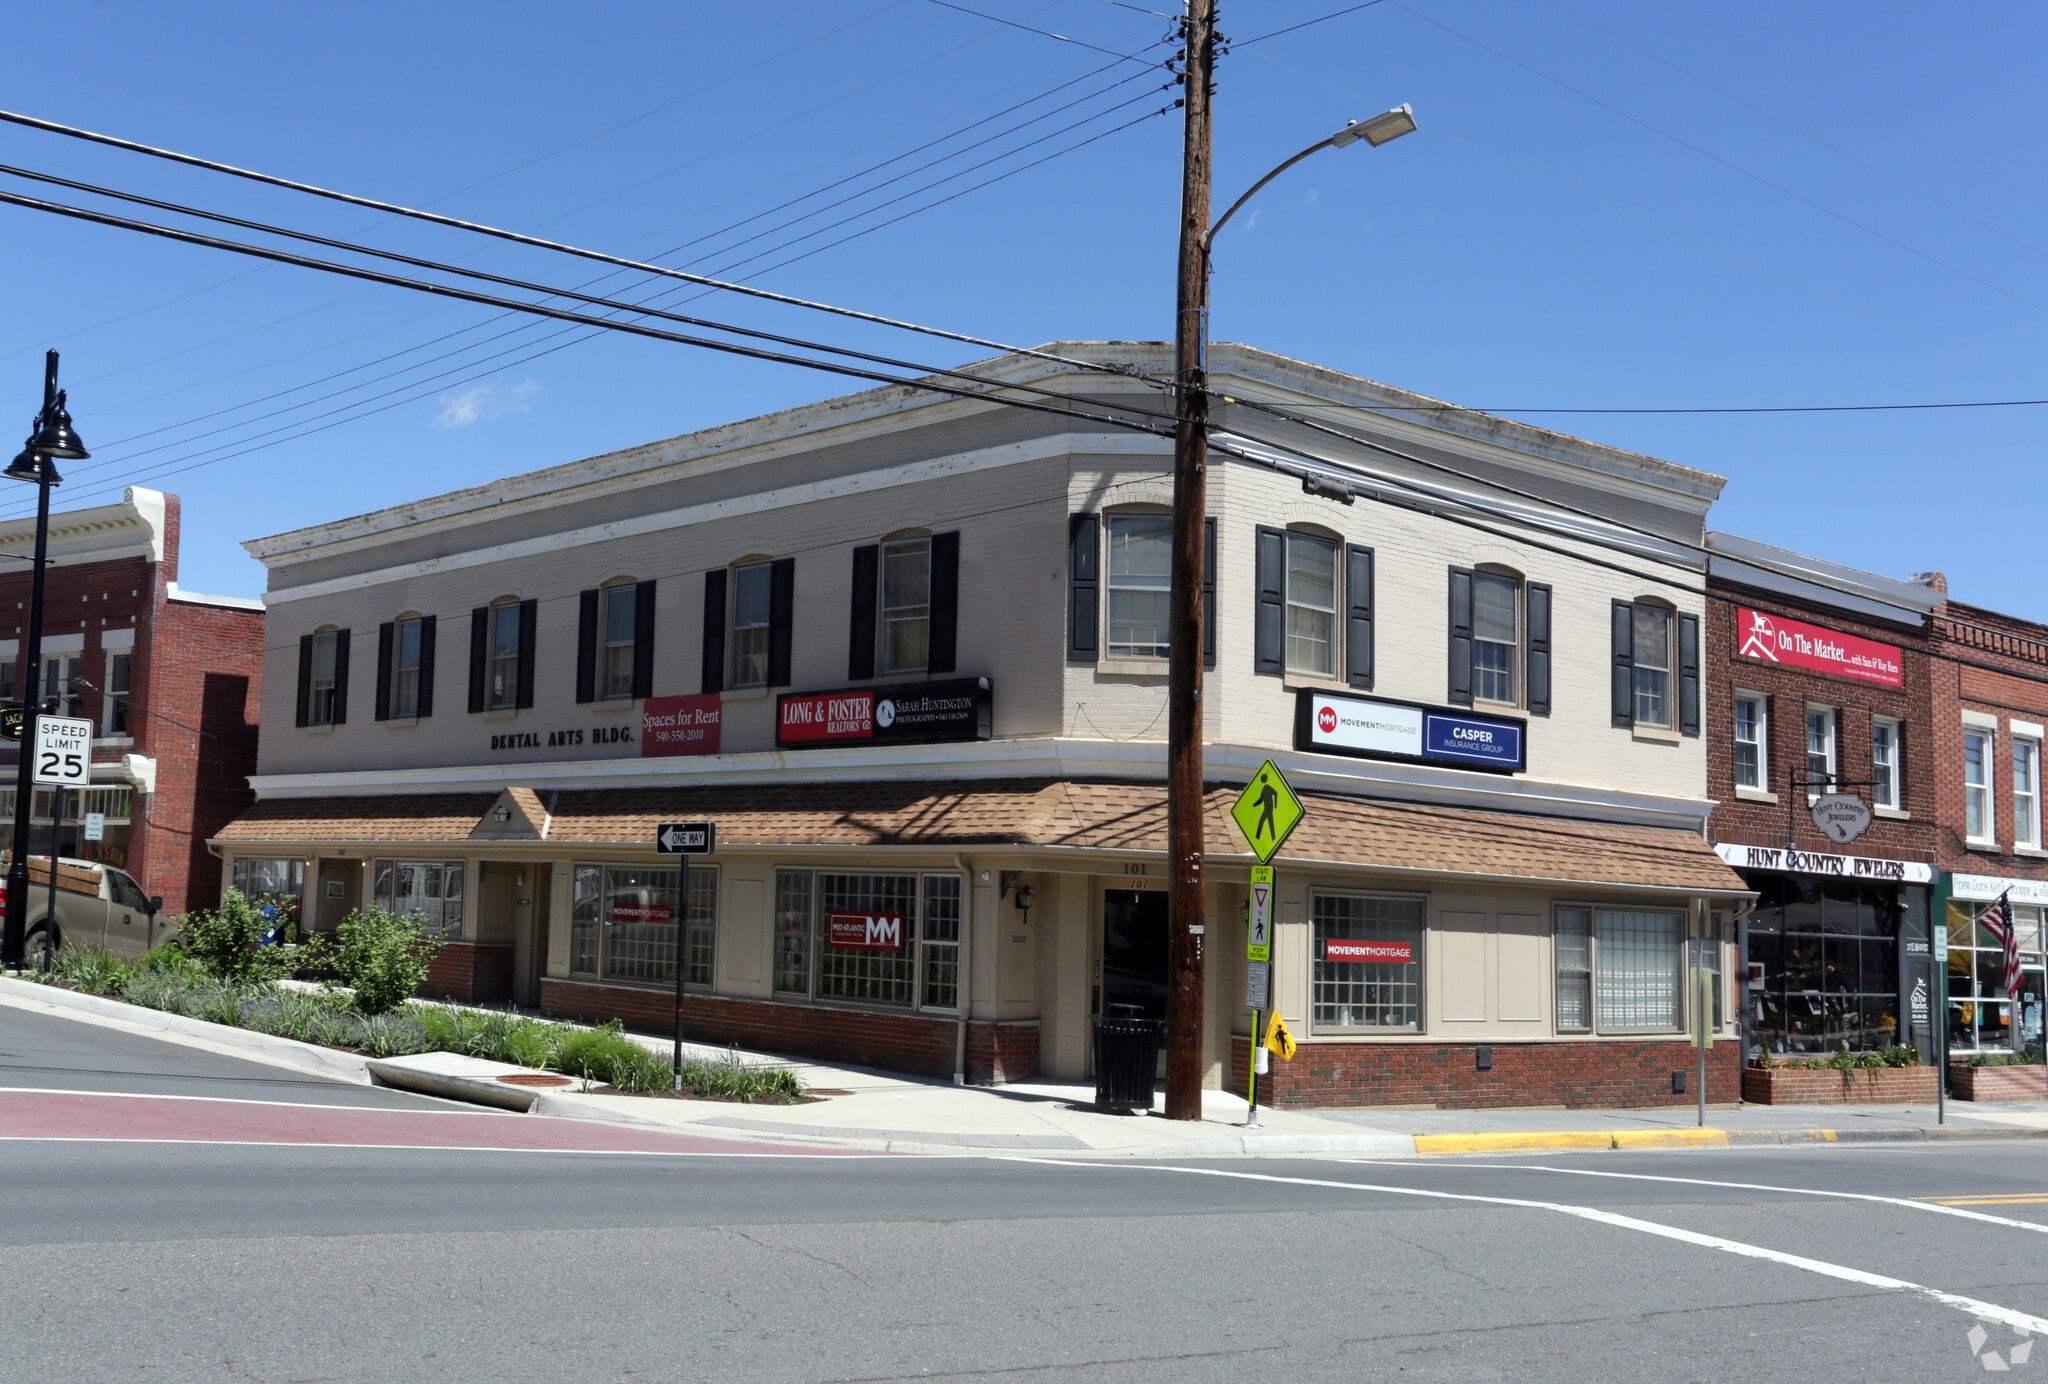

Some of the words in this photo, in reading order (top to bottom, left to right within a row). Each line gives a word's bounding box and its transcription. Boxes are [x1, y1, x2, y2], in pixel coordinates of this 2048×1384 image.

[1779, 630, 1792, 650] On
[1794, 634, 1812, 654] The
[783, 702, 812, 725] LONG
[815, 702, 825, 723] &
[828, 697, 870, 722] FOSTER
[896, 699, 919, 713] SARAH
[921, 697, 972, 711] HUNTINGTON
[643, 712, 675, 732] Spaces
[678, 709, 692, 725] for
[695, 708, 720, 725] Rent
[895, 713, 935, 724] PHOTOGRAPHY
[1319, 713, 1335, 727] MM
[1340, 717, 1417, 735] MOVEMENTMORTGAGE
[42, 724, 87, 738] SPEED
[827, 720, 860, 733] REALTORS
[491, 732, 540, 750] DENTAL
[547, 730, 583, 747] ARTS
[592, 726, 634, 744] BLDG.
[656, 729, 704, 742] 540-550-2010
[1453, 727, 1493, 743] CASPER
[46, 738, 81, 750] LIMIT
[1444, 739, 1480, 752] INSURANCE
[1481, 742, 1503, 754] GROUP
[40, 752, 83, 778] 25
[1815, 803, 1833, 816] HUNT
[1834, 801, 1866, 816] COUNTRY
[1826, 813, 1857, 824] JEWELERS
[672, 832, 687, 844] ONE
[689, 832, 704, 844] WAY
[1123, 863, 1147, 875] 101
[1747, 848, 1781, 867] HUNT
[1786, 851, 1847, 874] COUNTRY
[1850, 858, 1905, 878] JEWELERS
[1255, 867, 1269, 875] STATE
[1131, 881, 1148, 889] 101
[832, 923, 865, 932] MID-ATLANTIC
[866, 916, 900, 947] MM
[1327, 945, 1411, 957] MOVEMENTMORTGAGE
